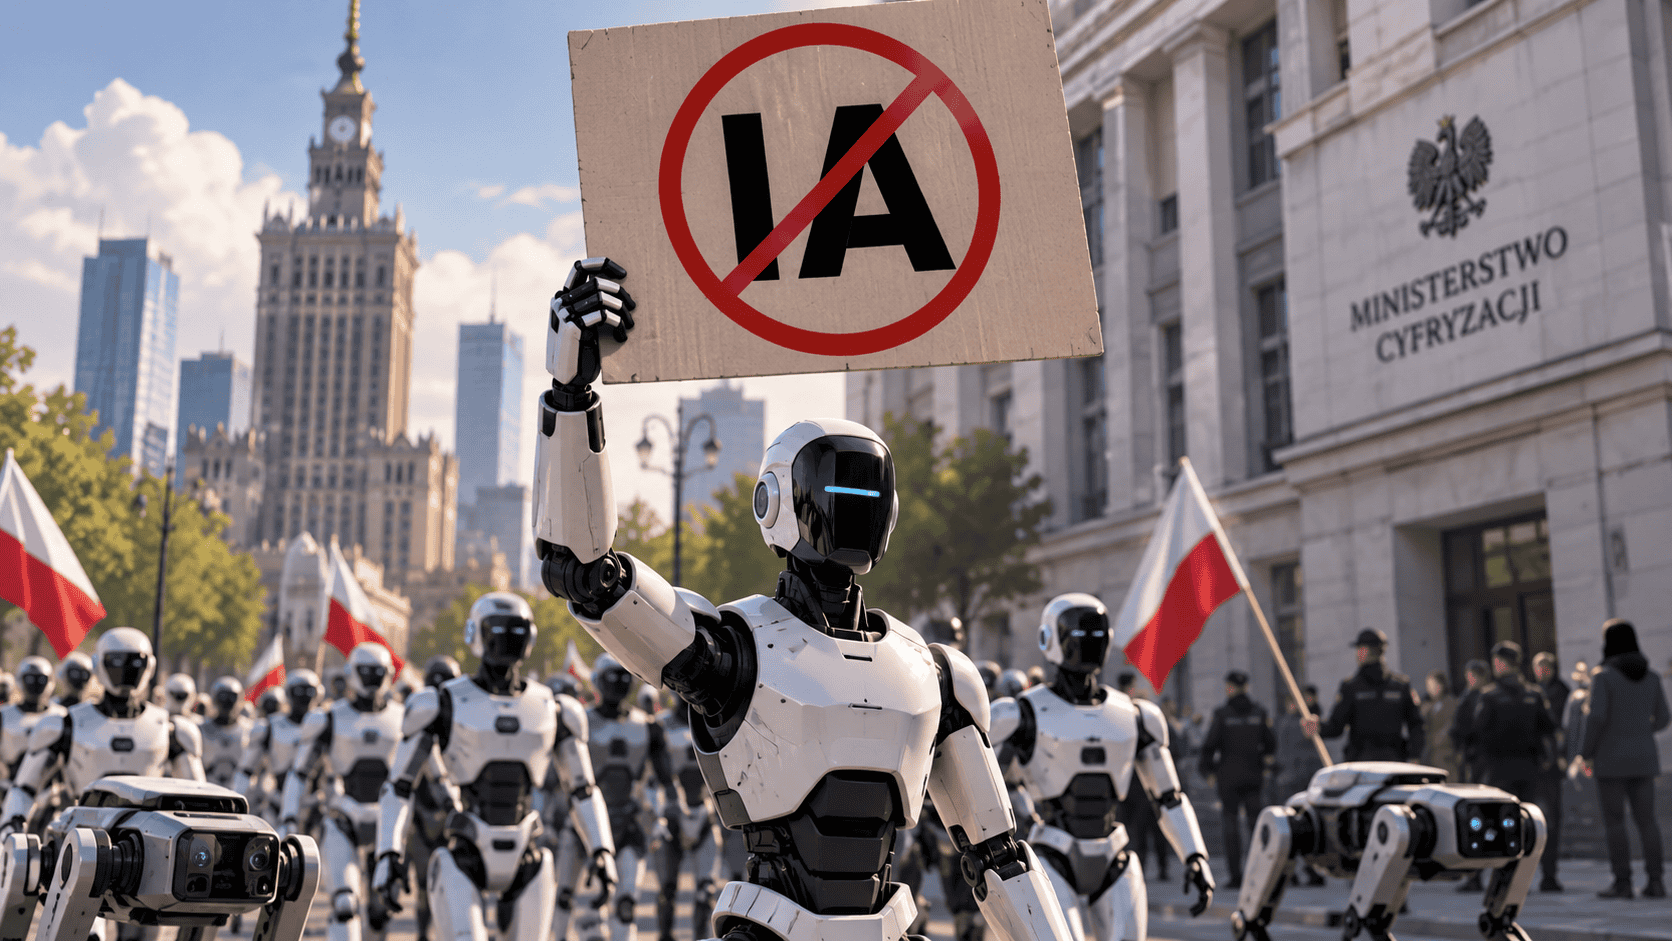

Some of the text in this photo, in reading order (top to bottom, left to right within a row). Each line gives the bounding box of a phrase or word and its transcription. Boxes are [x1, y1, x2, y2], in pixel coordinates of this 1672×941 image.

[721, 103, 957, 281] IA
[1350, 225, 1568, 332] MINISTERSTWO
[1375, 279, 1540, 363] CYFRYZACJI
